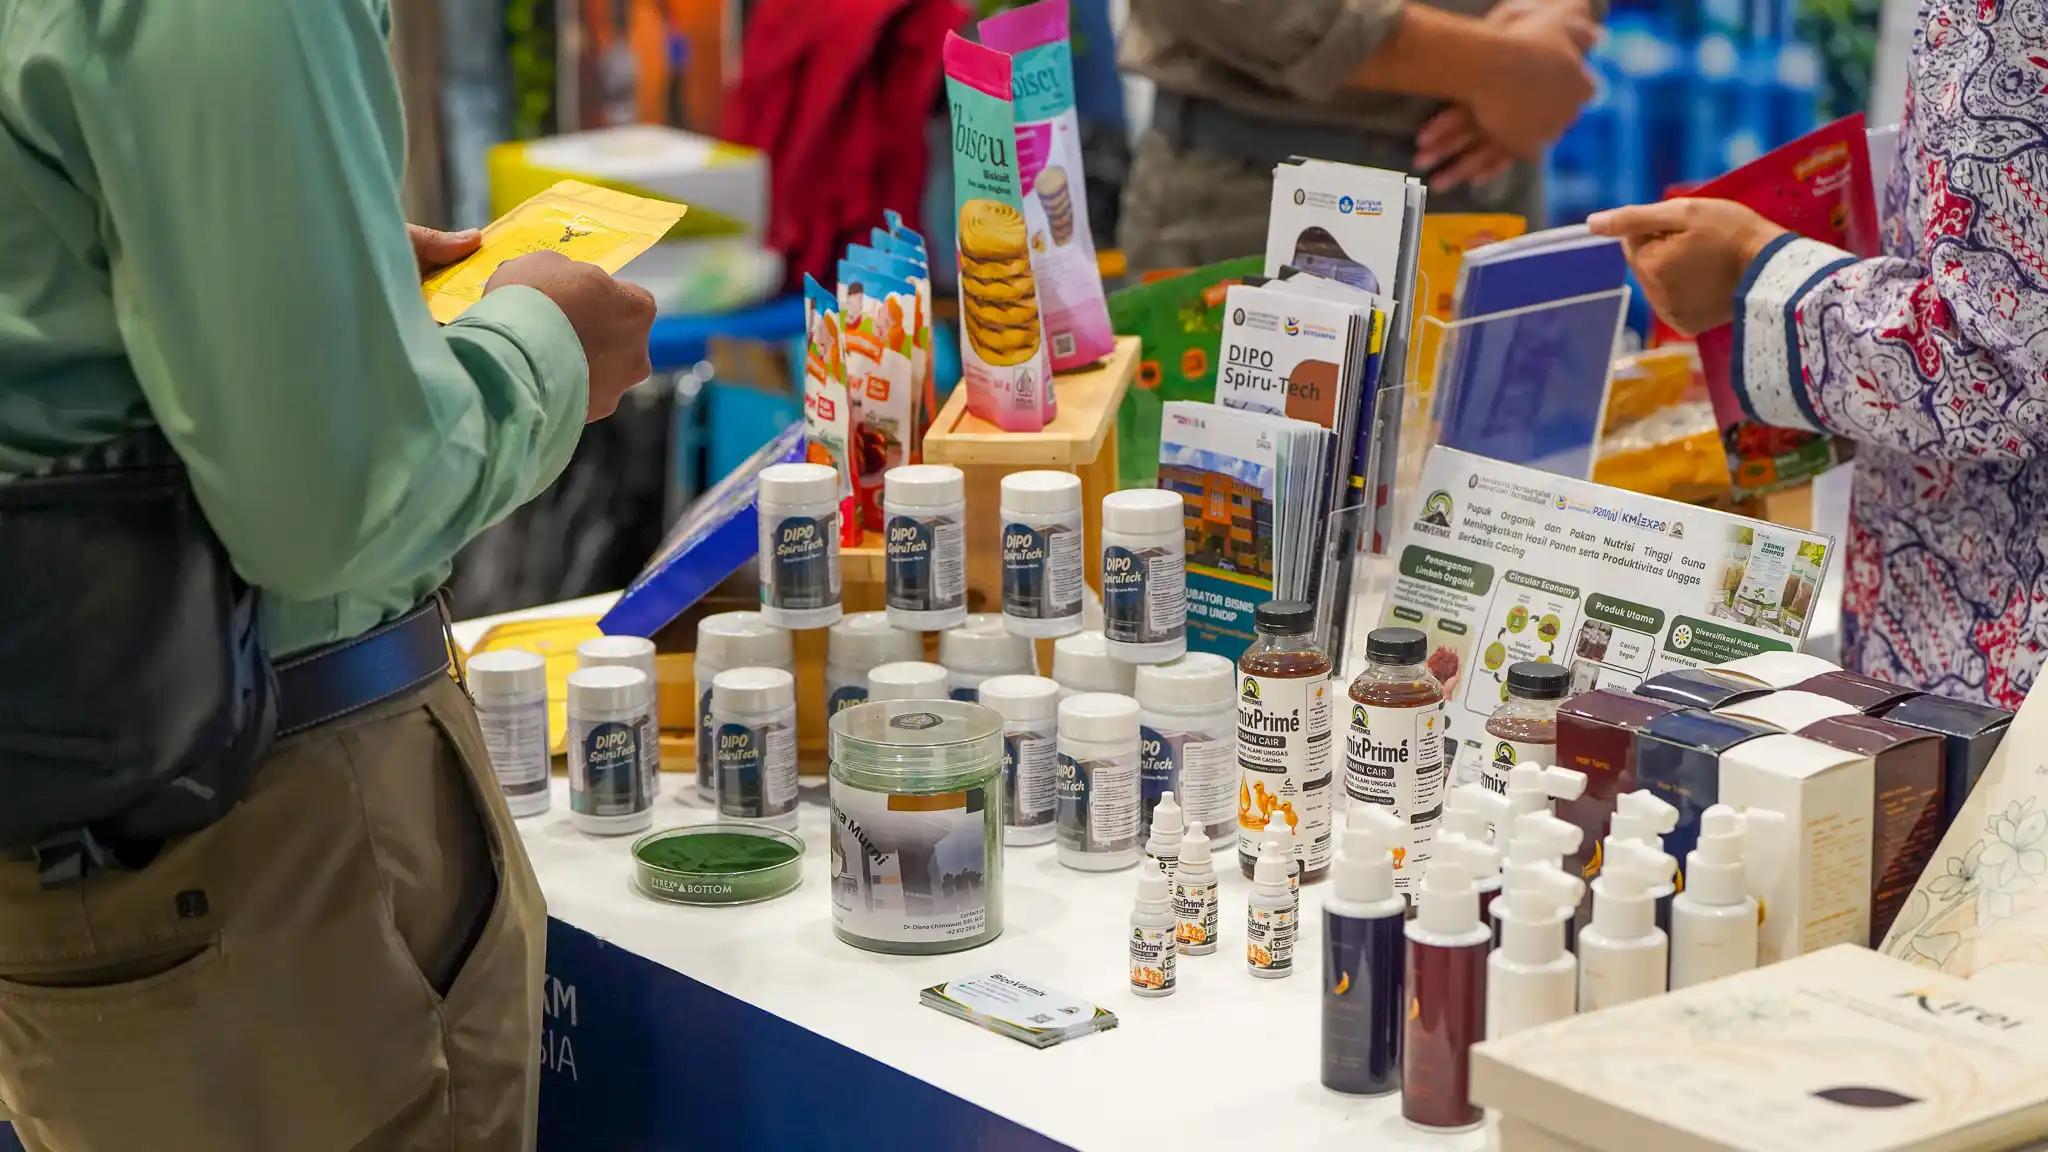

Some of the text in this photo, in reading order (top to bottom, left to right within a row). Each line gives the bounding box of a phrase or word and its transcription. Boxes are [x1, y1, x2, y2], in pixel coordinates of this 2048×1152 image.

[1229, 344, 1273, 368] DIPO
[1223, 367, 1320, 401] Spiru-Tech
[783, 525, 814, 542] DIPO
[891, 526, 917, 541] DIPO
[1006, 534, 1032, 548] DIPO
[1466, 503, 1706, 570] Pupuk Organik dan Pakan Nutrisi Tinggi Guna
[1458, 532, 1525, 558] Berbasis Cacing
[1463, 517, 1701, 586] Meningkatkan Hasil Panen serta Produktivitas Unggas
[1763, 542, 1786, 552] VERMIX
[1106, 557, 1131, 571] DIPO
[1425, 554, 1472, 574] Penanganan
[1415, 565, 1476, 589] Limbah Organik
[1509, 573, 1577, 598] Circular Economy
[1186, 587, 1254, 614] UBATOR BISNIS
[1209, 607, 1237, 622] UNDIP
[1595, 602, 1655, 624] Produk Utama
[1619, 641, 1640, 653] Cacing
[1695, 628, 1760, 650] Diversifikasi Produk
[1619, 651, 1636, 660] Segar
[1713, 643, 1731, 652] untuk
[1730, 646, 1754, 657] kebutuh
[596, 731, 627, 749] DIPO
[721, 734, 749, 748] DIPO
[1140, 740, 1161, 756] IPO
[1258, 738, 1280, 746] CAIR
[589, 742, 636, 764] SpiruTech
[1140, 757, 1174, 770] ruTech
[1366, 767, 1387, 776] CAIR
[1370, 780, 1397, 788] UNGGAS
[848, 819, 890, 867] Murni
[687, 884, 732, 894] BOTTOM
[960, 909, 979, 918] Contact
